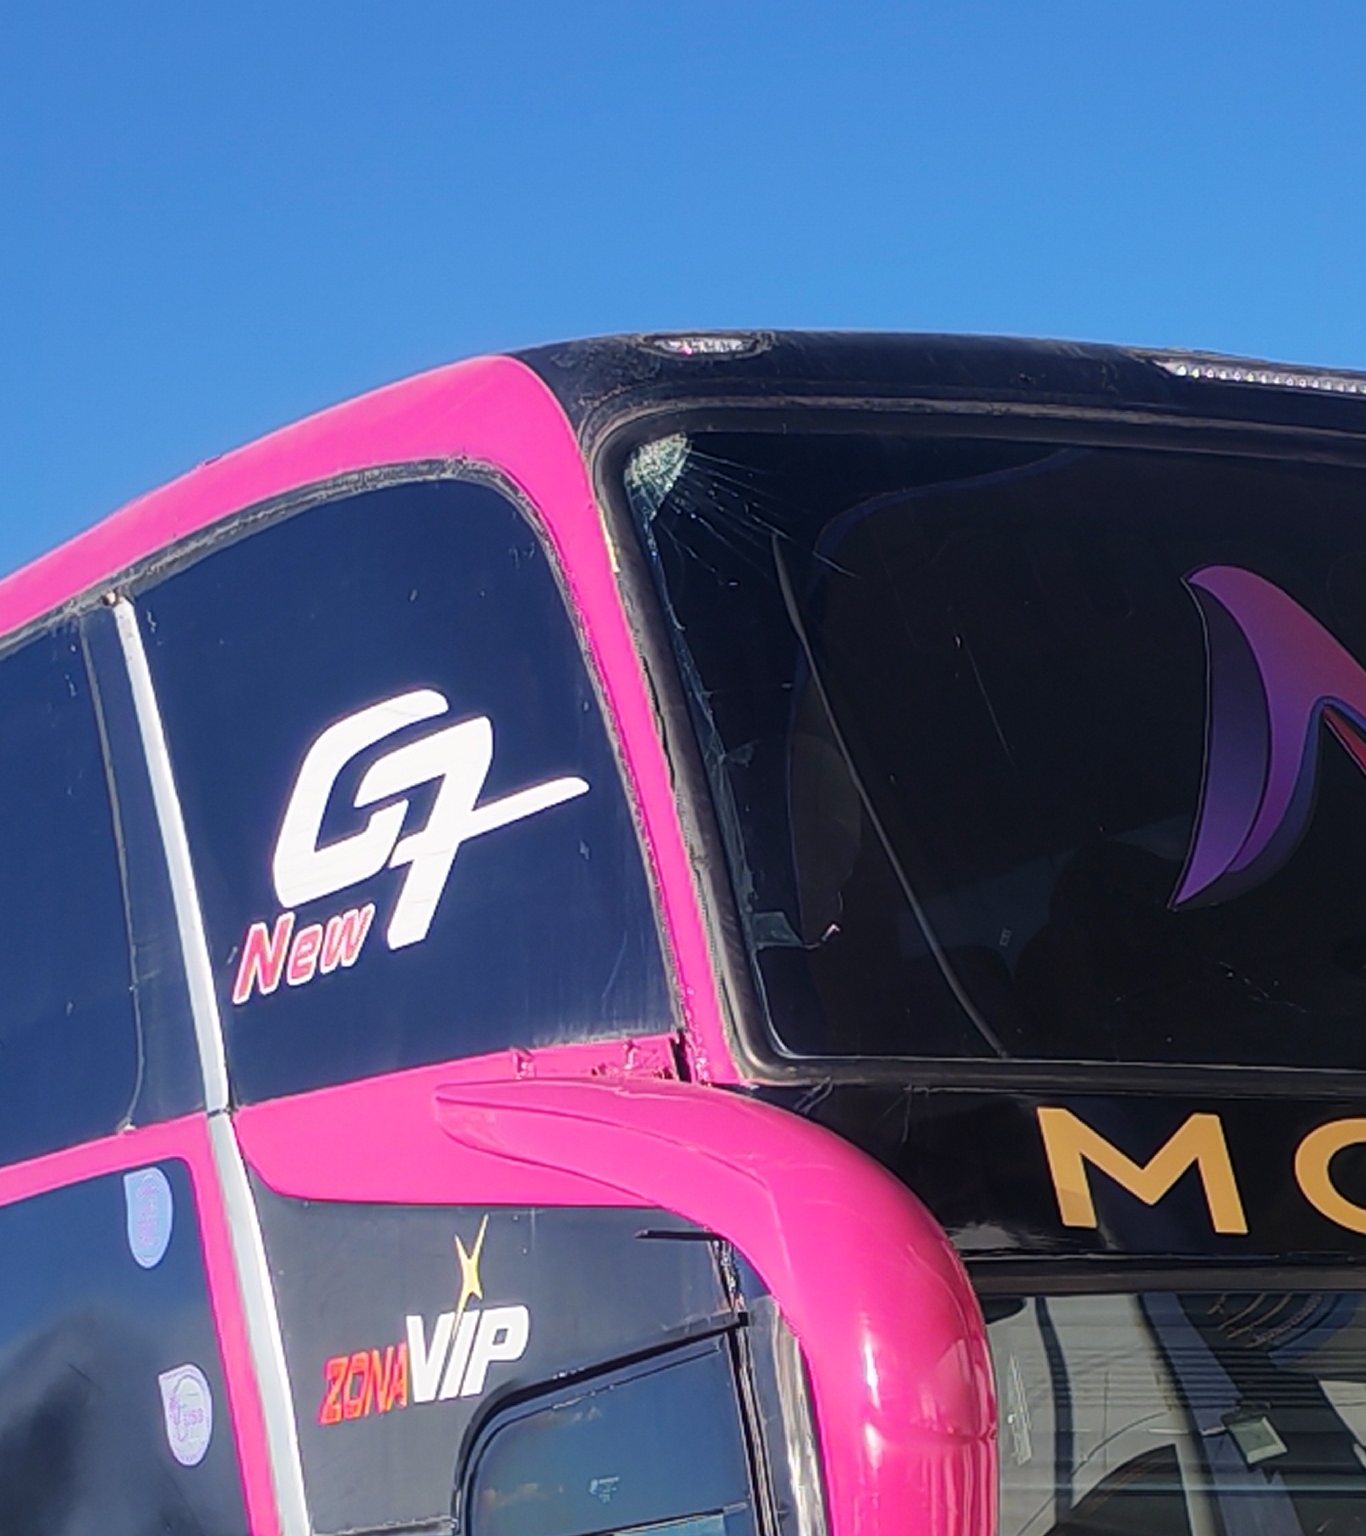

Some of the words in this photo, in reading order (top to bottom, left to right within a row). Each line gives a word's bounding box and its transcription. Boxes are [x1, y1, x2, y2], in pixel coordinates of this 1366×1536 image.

[233, 902, 376, 1006] New
[318, 1340, 409, 1426] ZONA
[405, 1305, 530, 1404] VIP
